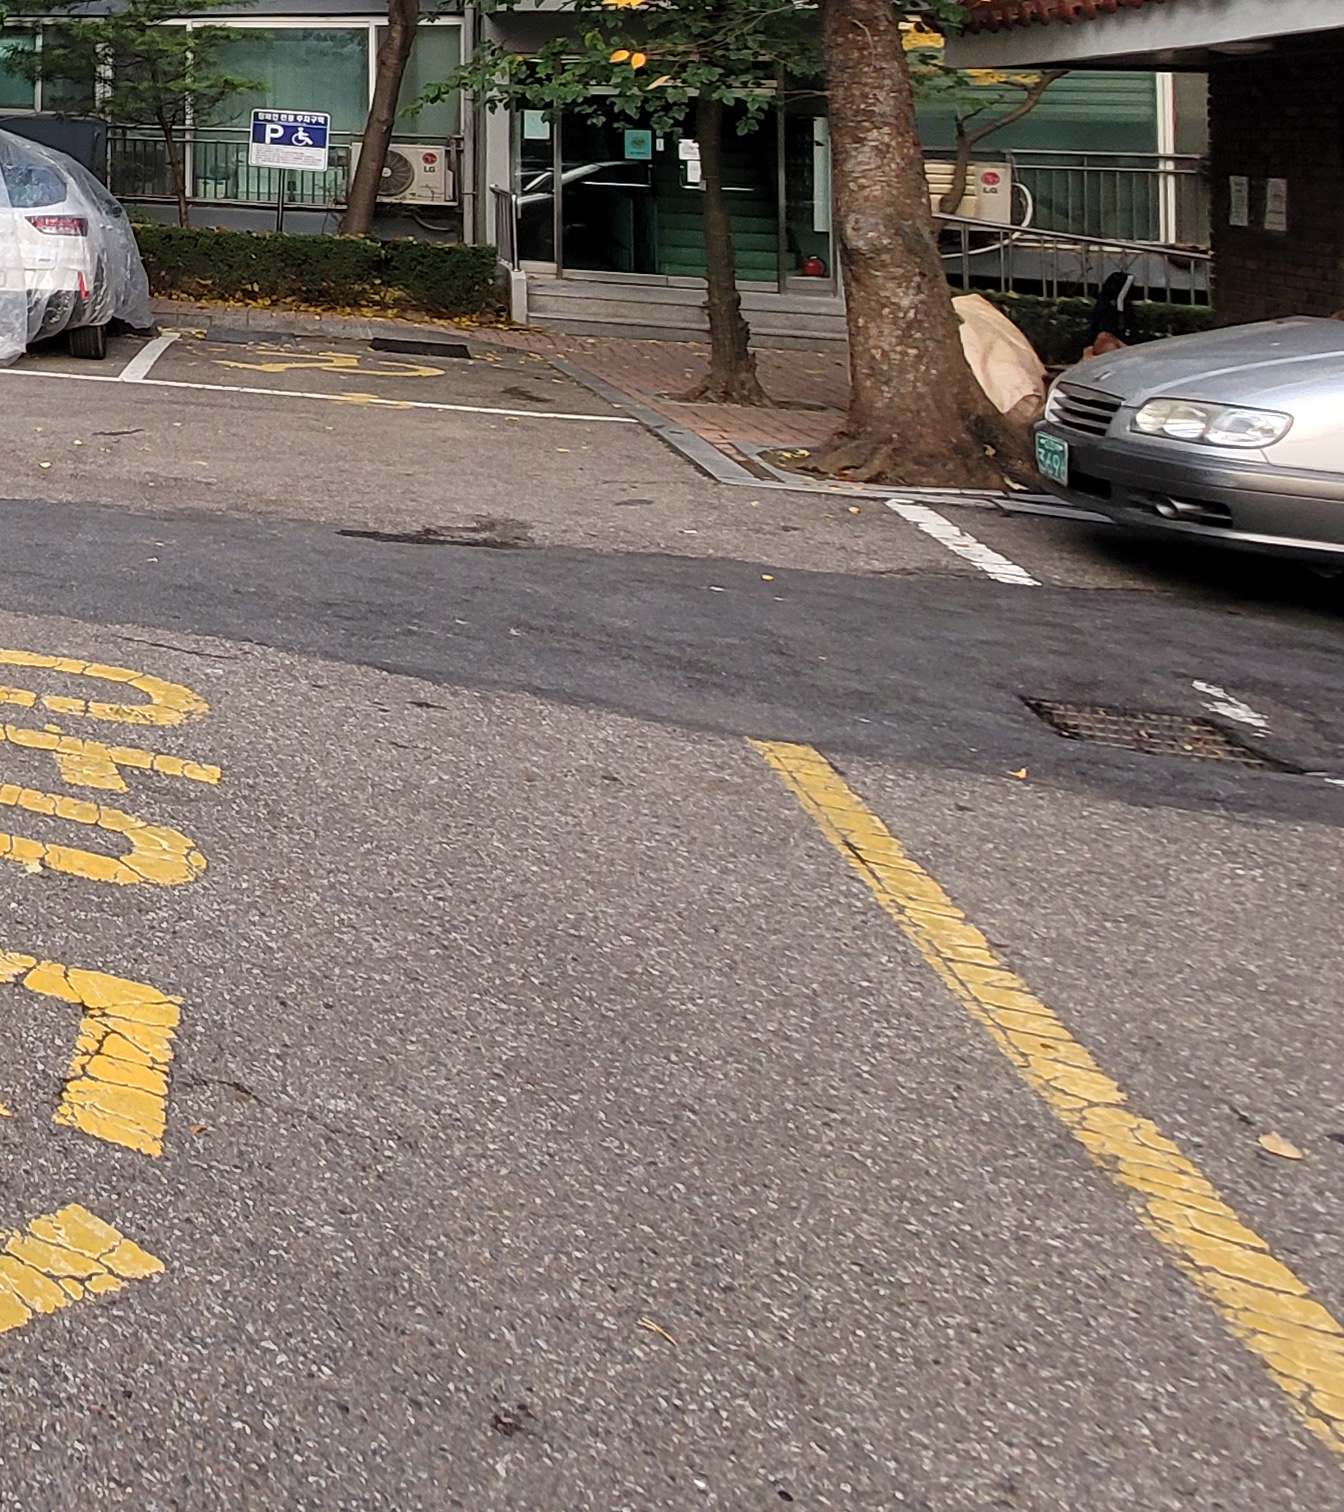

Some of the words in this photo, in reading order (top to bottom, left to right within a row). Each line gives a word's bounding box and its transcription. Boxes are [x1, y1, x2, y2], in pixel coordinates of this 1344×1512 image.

[280, 113, 295, 122] 전용
[296, 115, 325, 124] 주차구역
[265, 123, 285, 145] P
[982, 186, 998, 194] LG
